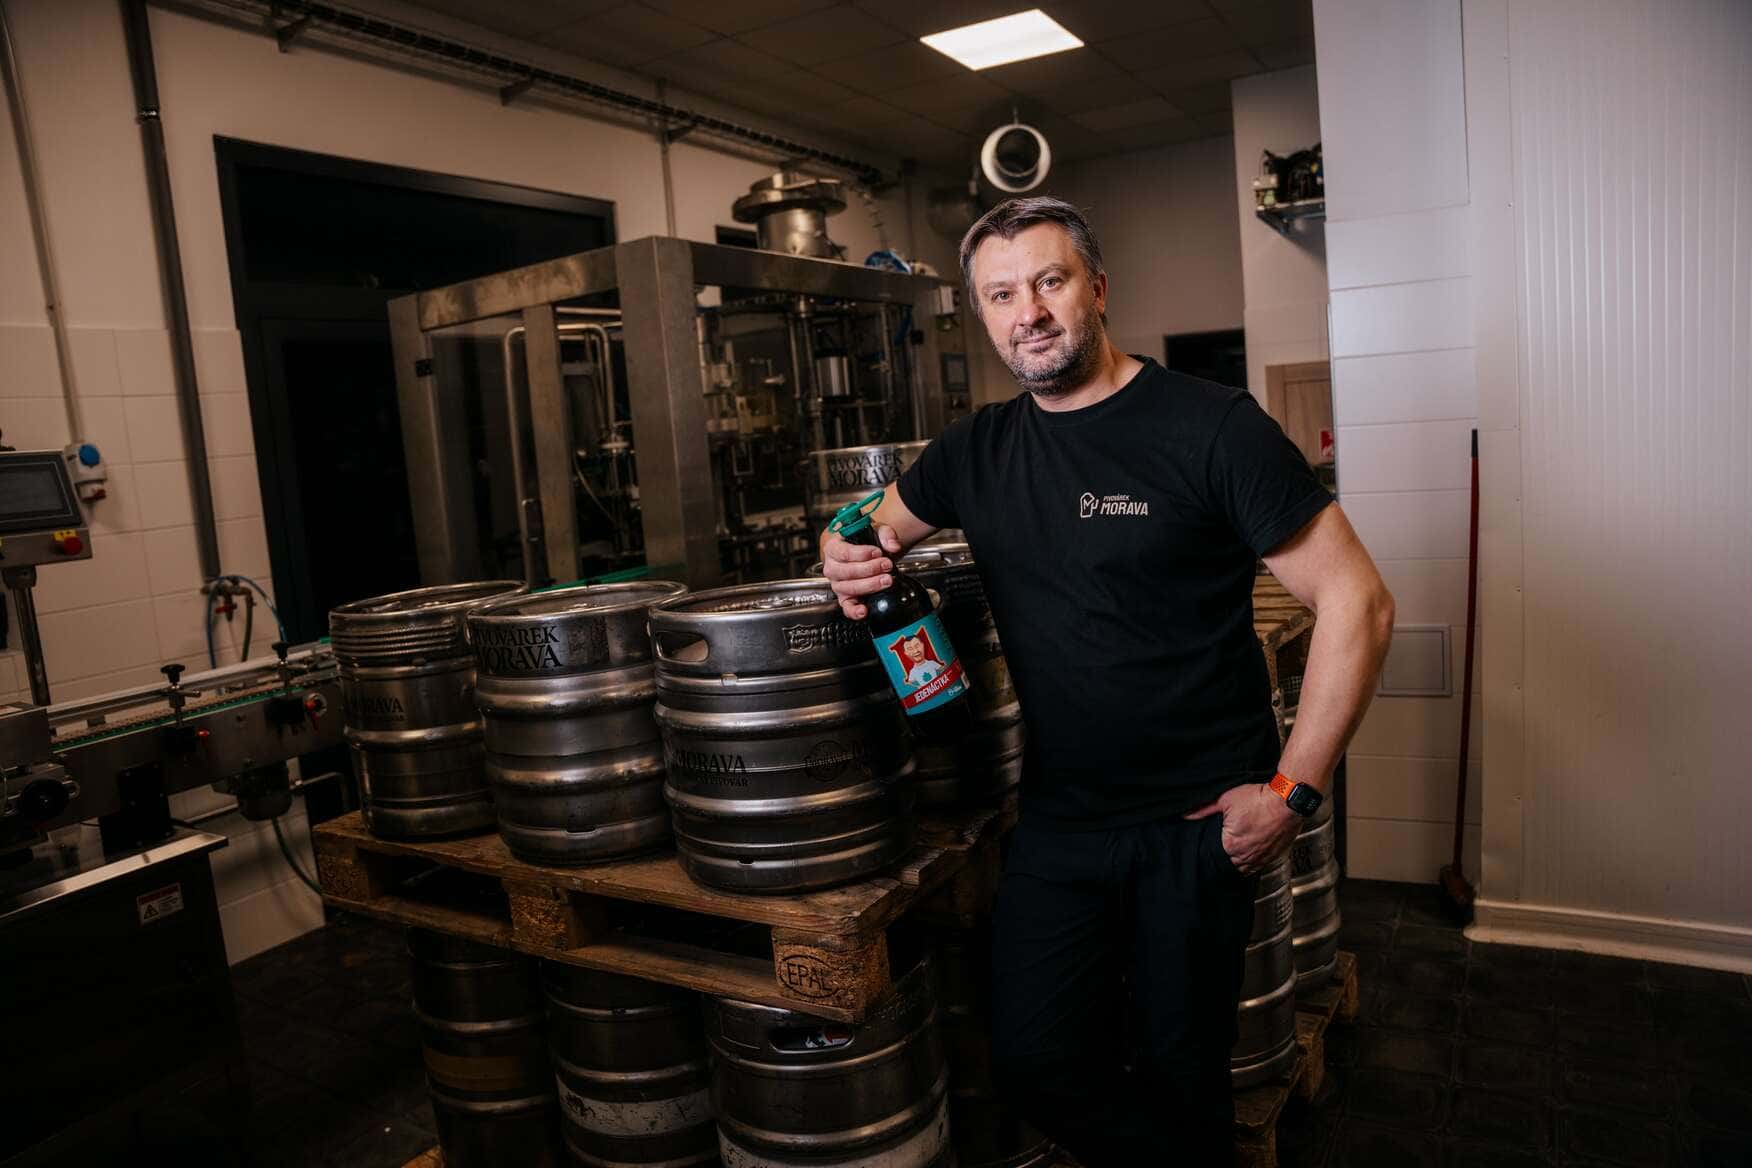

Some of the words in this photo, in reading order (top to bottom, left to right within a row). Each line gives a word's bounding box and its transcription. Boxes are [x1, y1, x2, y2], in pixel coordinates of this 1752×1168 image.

[1100, 502, 1149, 516] MORAVA
[913, 673, 950, 703] JEDENÁCTKA
[786, 962, 833, 992] EPAL
